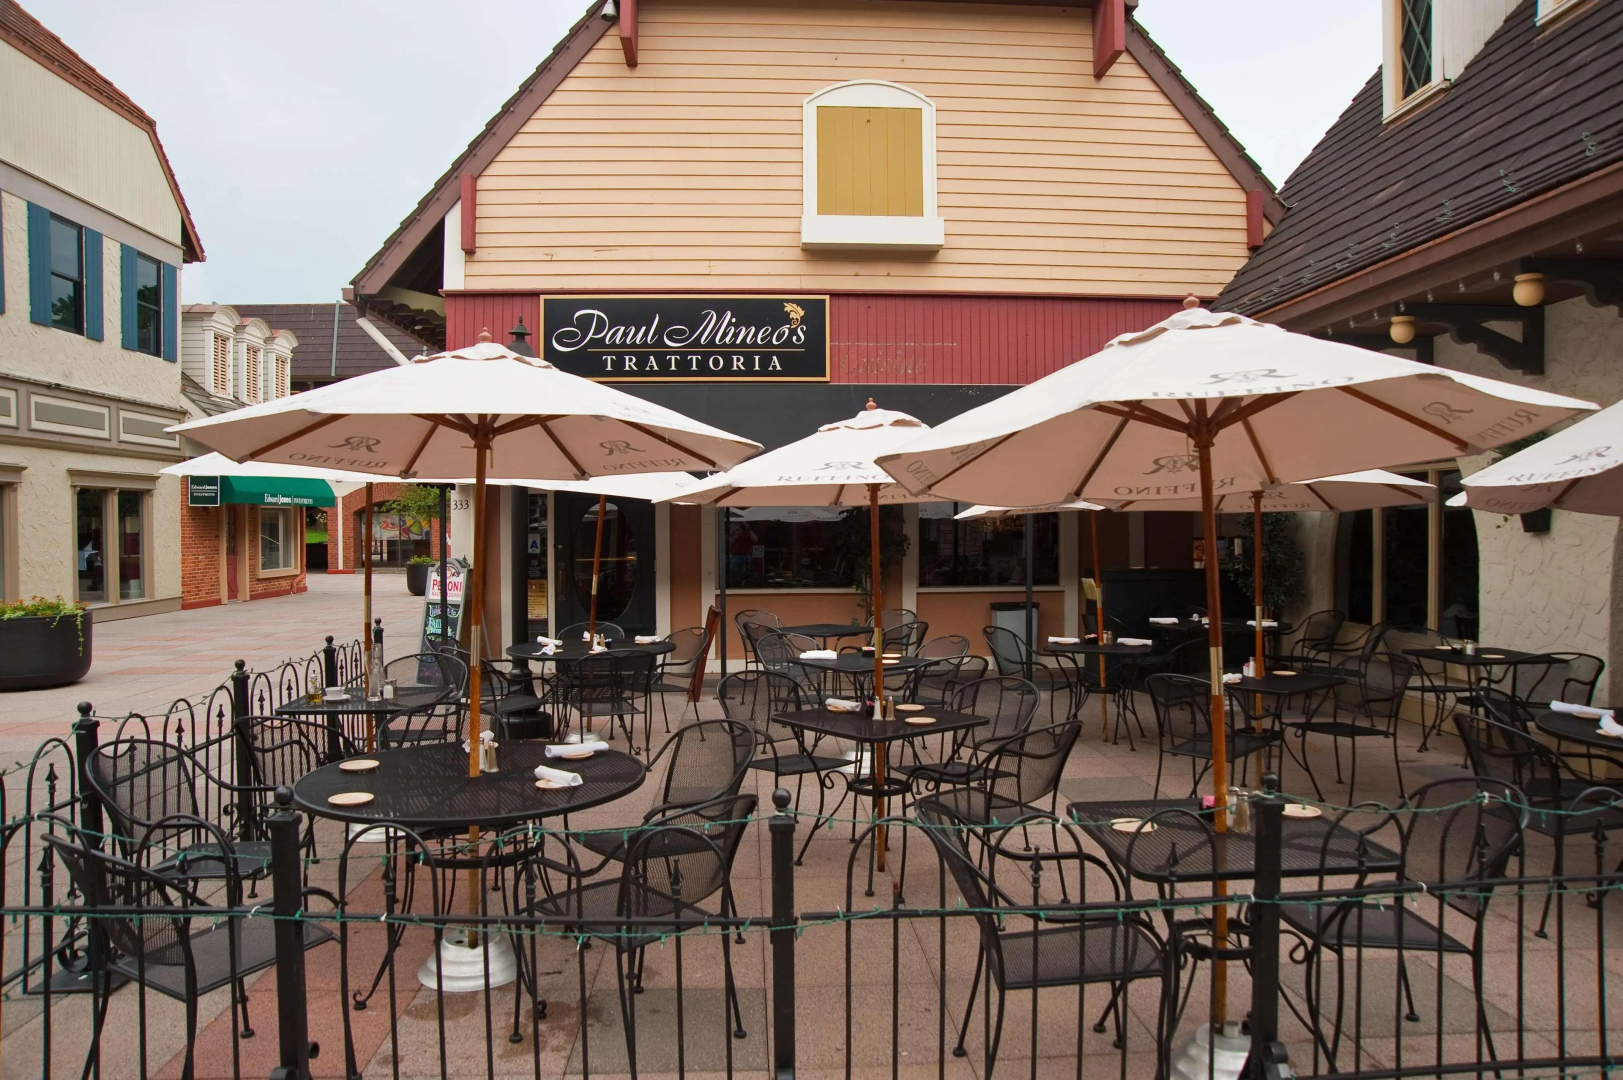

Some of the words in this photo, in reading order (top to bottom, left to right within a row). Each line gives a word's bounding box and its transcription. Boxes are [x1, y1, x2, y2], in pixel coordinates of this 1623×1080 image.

[552, 309, 659, 352] Paul
[602, 355, 783, 371] TRATTORIA
[776, 473, 889, 483] RUFFINO
[452, 499, 470, 511] 333
[529, 540, 539, 550] A
